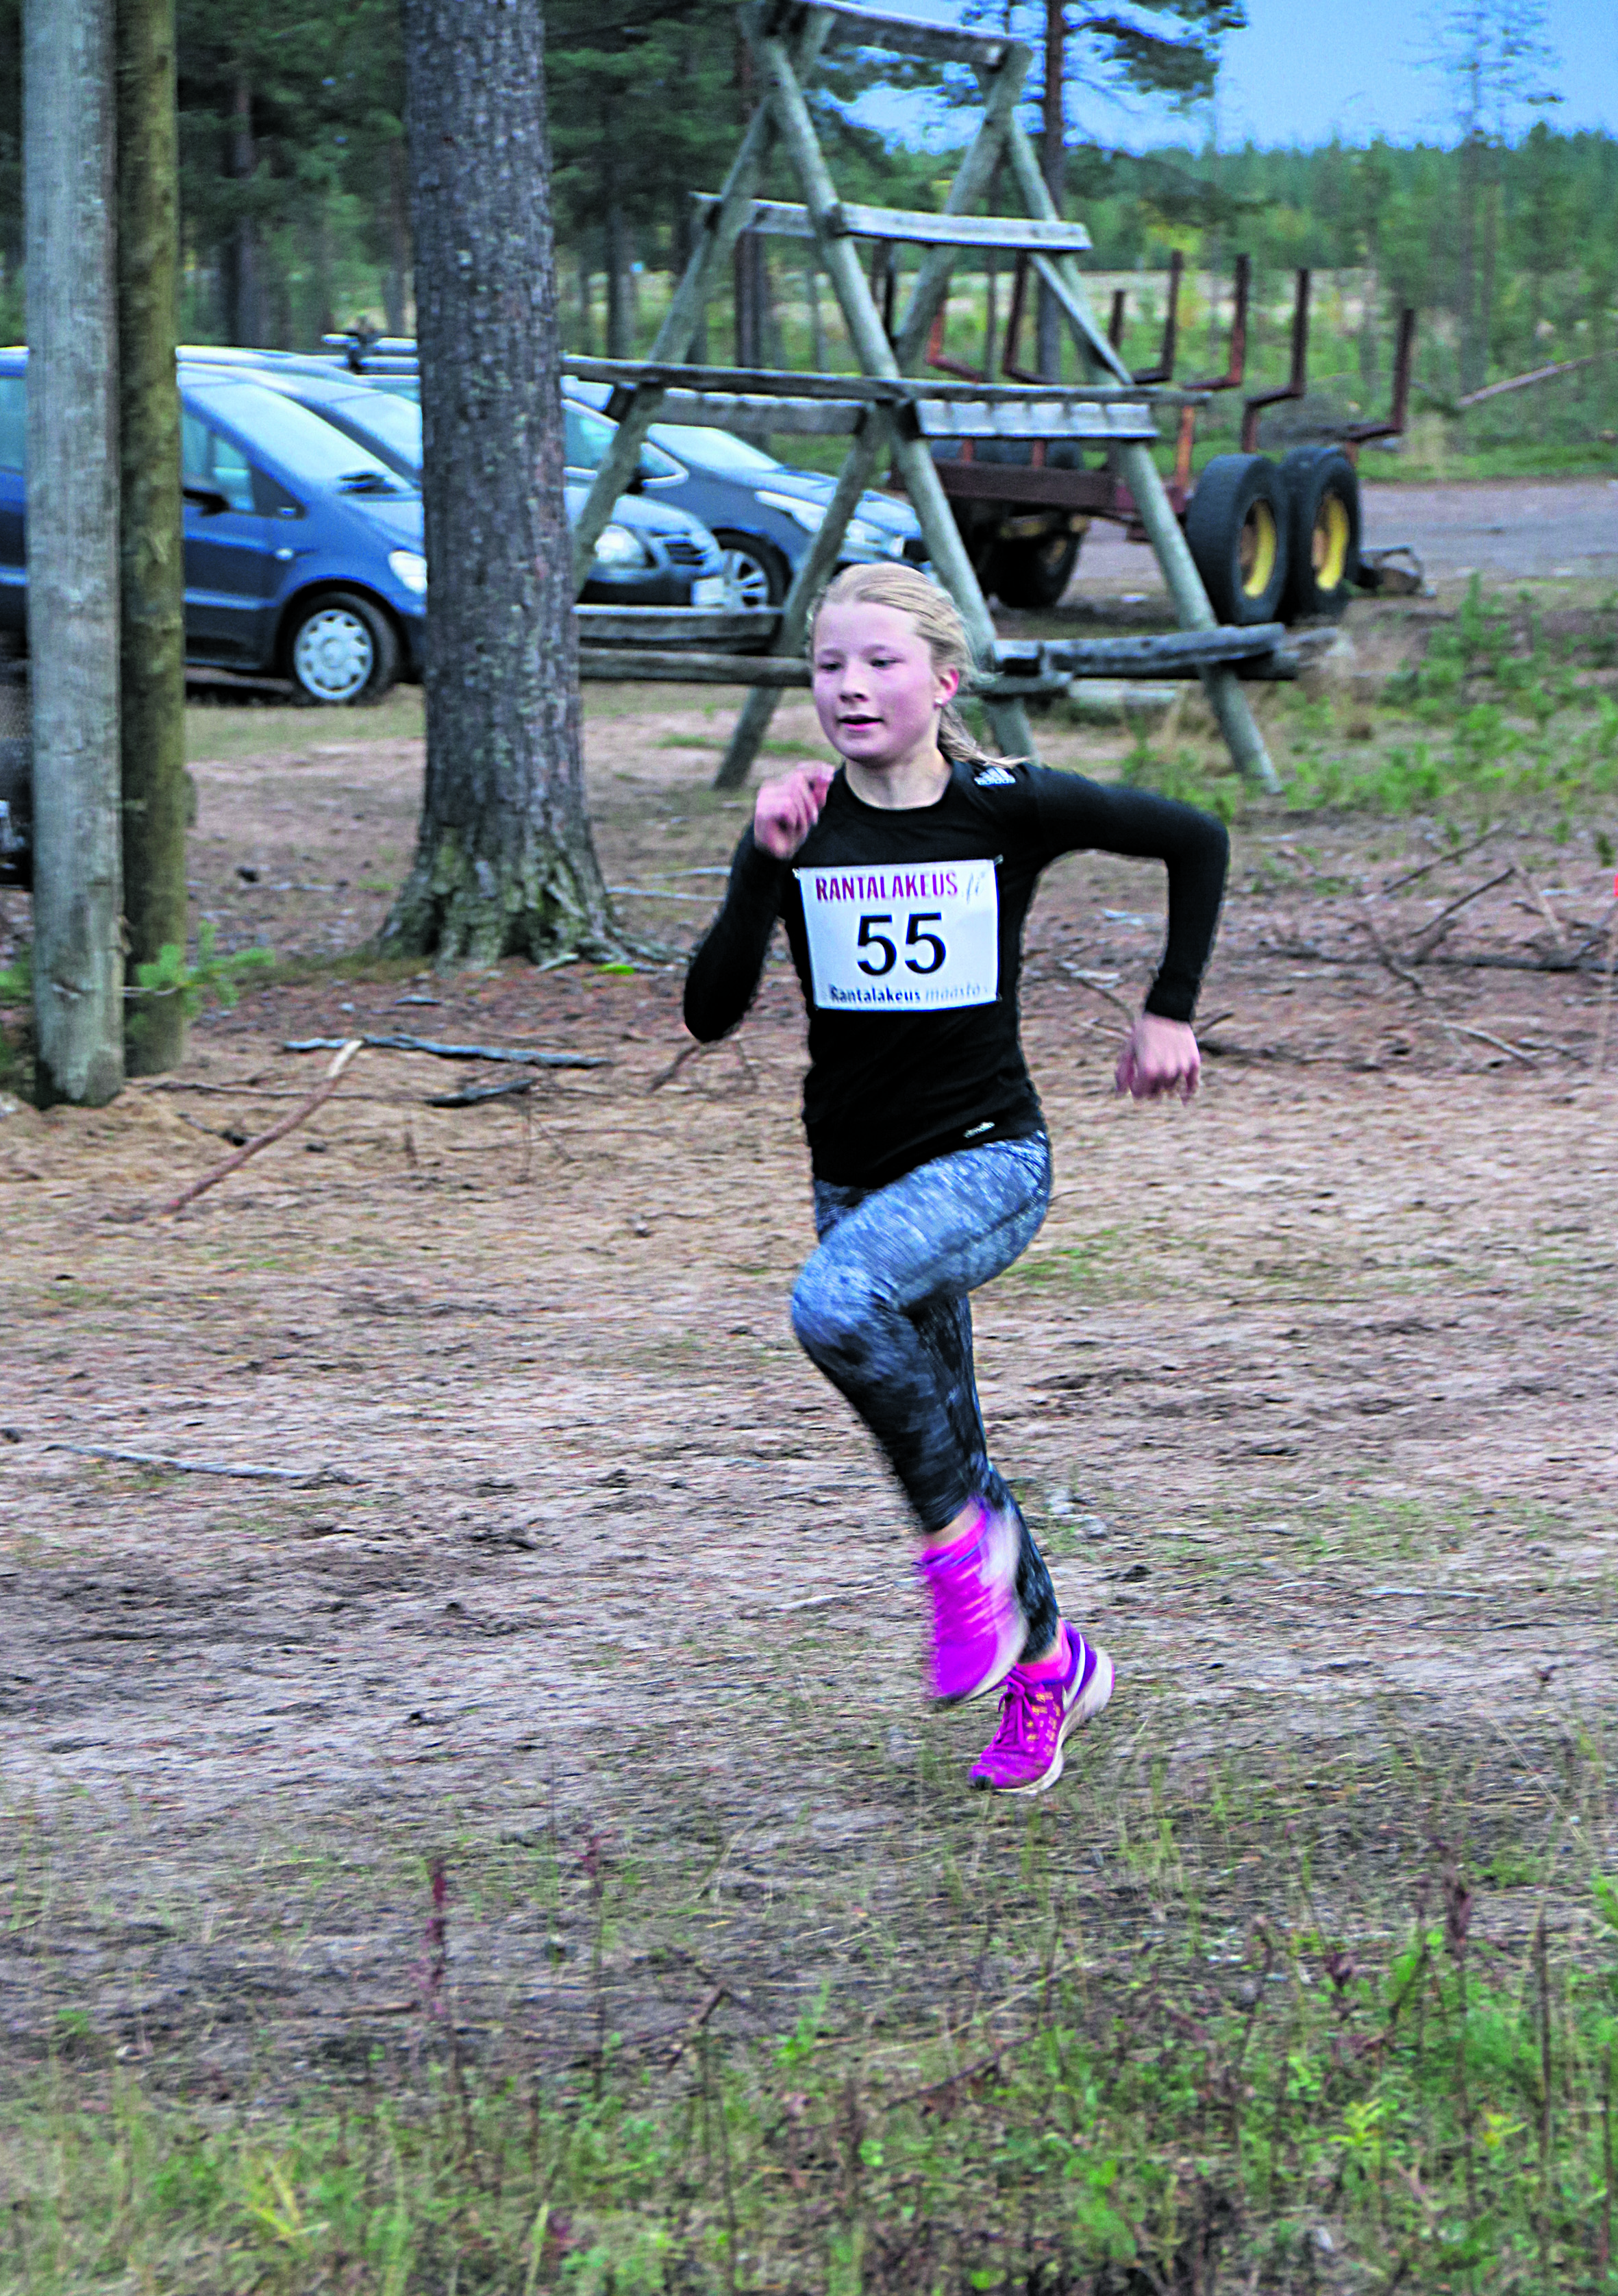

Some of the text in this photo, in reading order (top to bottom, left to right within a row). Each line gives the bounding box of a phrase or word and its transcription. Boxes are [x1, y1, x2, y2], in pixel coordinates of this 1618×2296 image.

[816, 870, 958, 901] RANTALAKEUS
[857, 912, 947, 976] 55
[829, 984, 921, 1003] Rantalakeus
